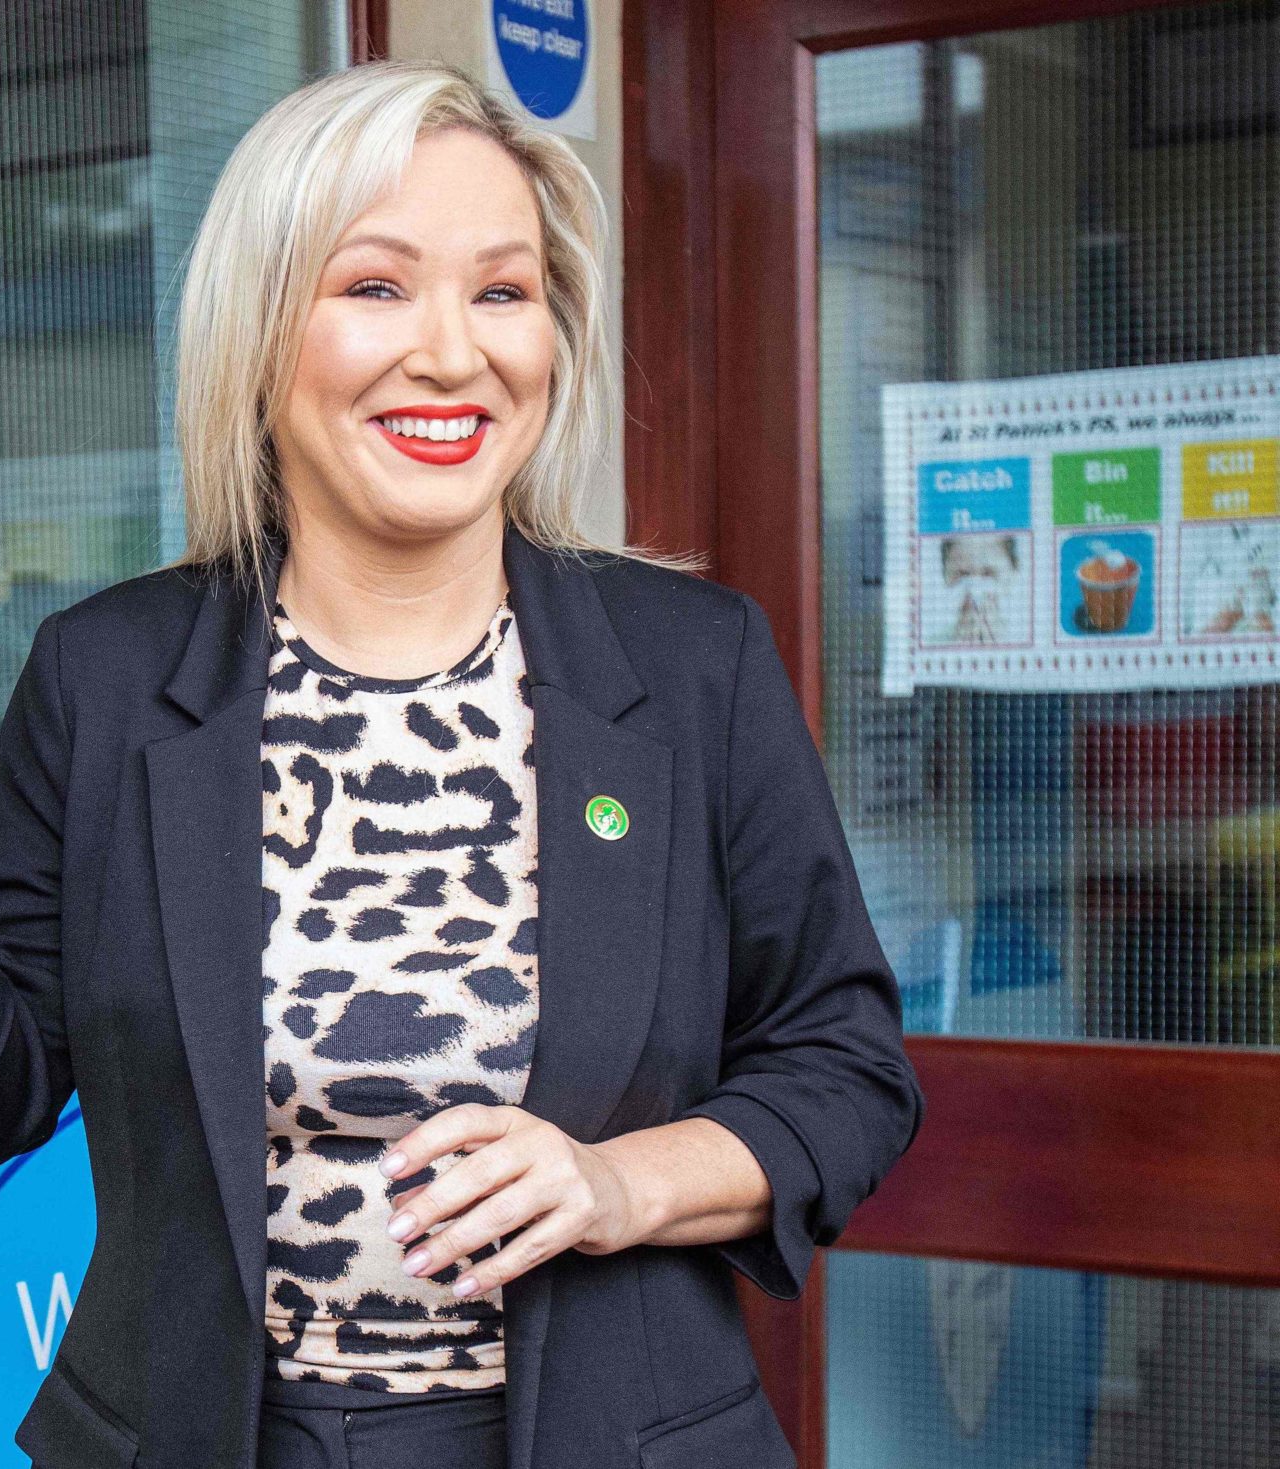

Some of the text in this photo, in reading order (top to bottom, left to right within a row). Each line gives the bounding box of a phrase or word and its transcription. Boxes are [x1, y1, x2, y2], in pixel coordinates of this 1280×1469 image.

[498, 13, 583, 59] keep clear
[1128, 416, 1157, 430] we
[1084, 459, 1128, 484] Bin
[1207, 451, 1255, 476] Kill
[935, 467, 1013, 492] Catch
